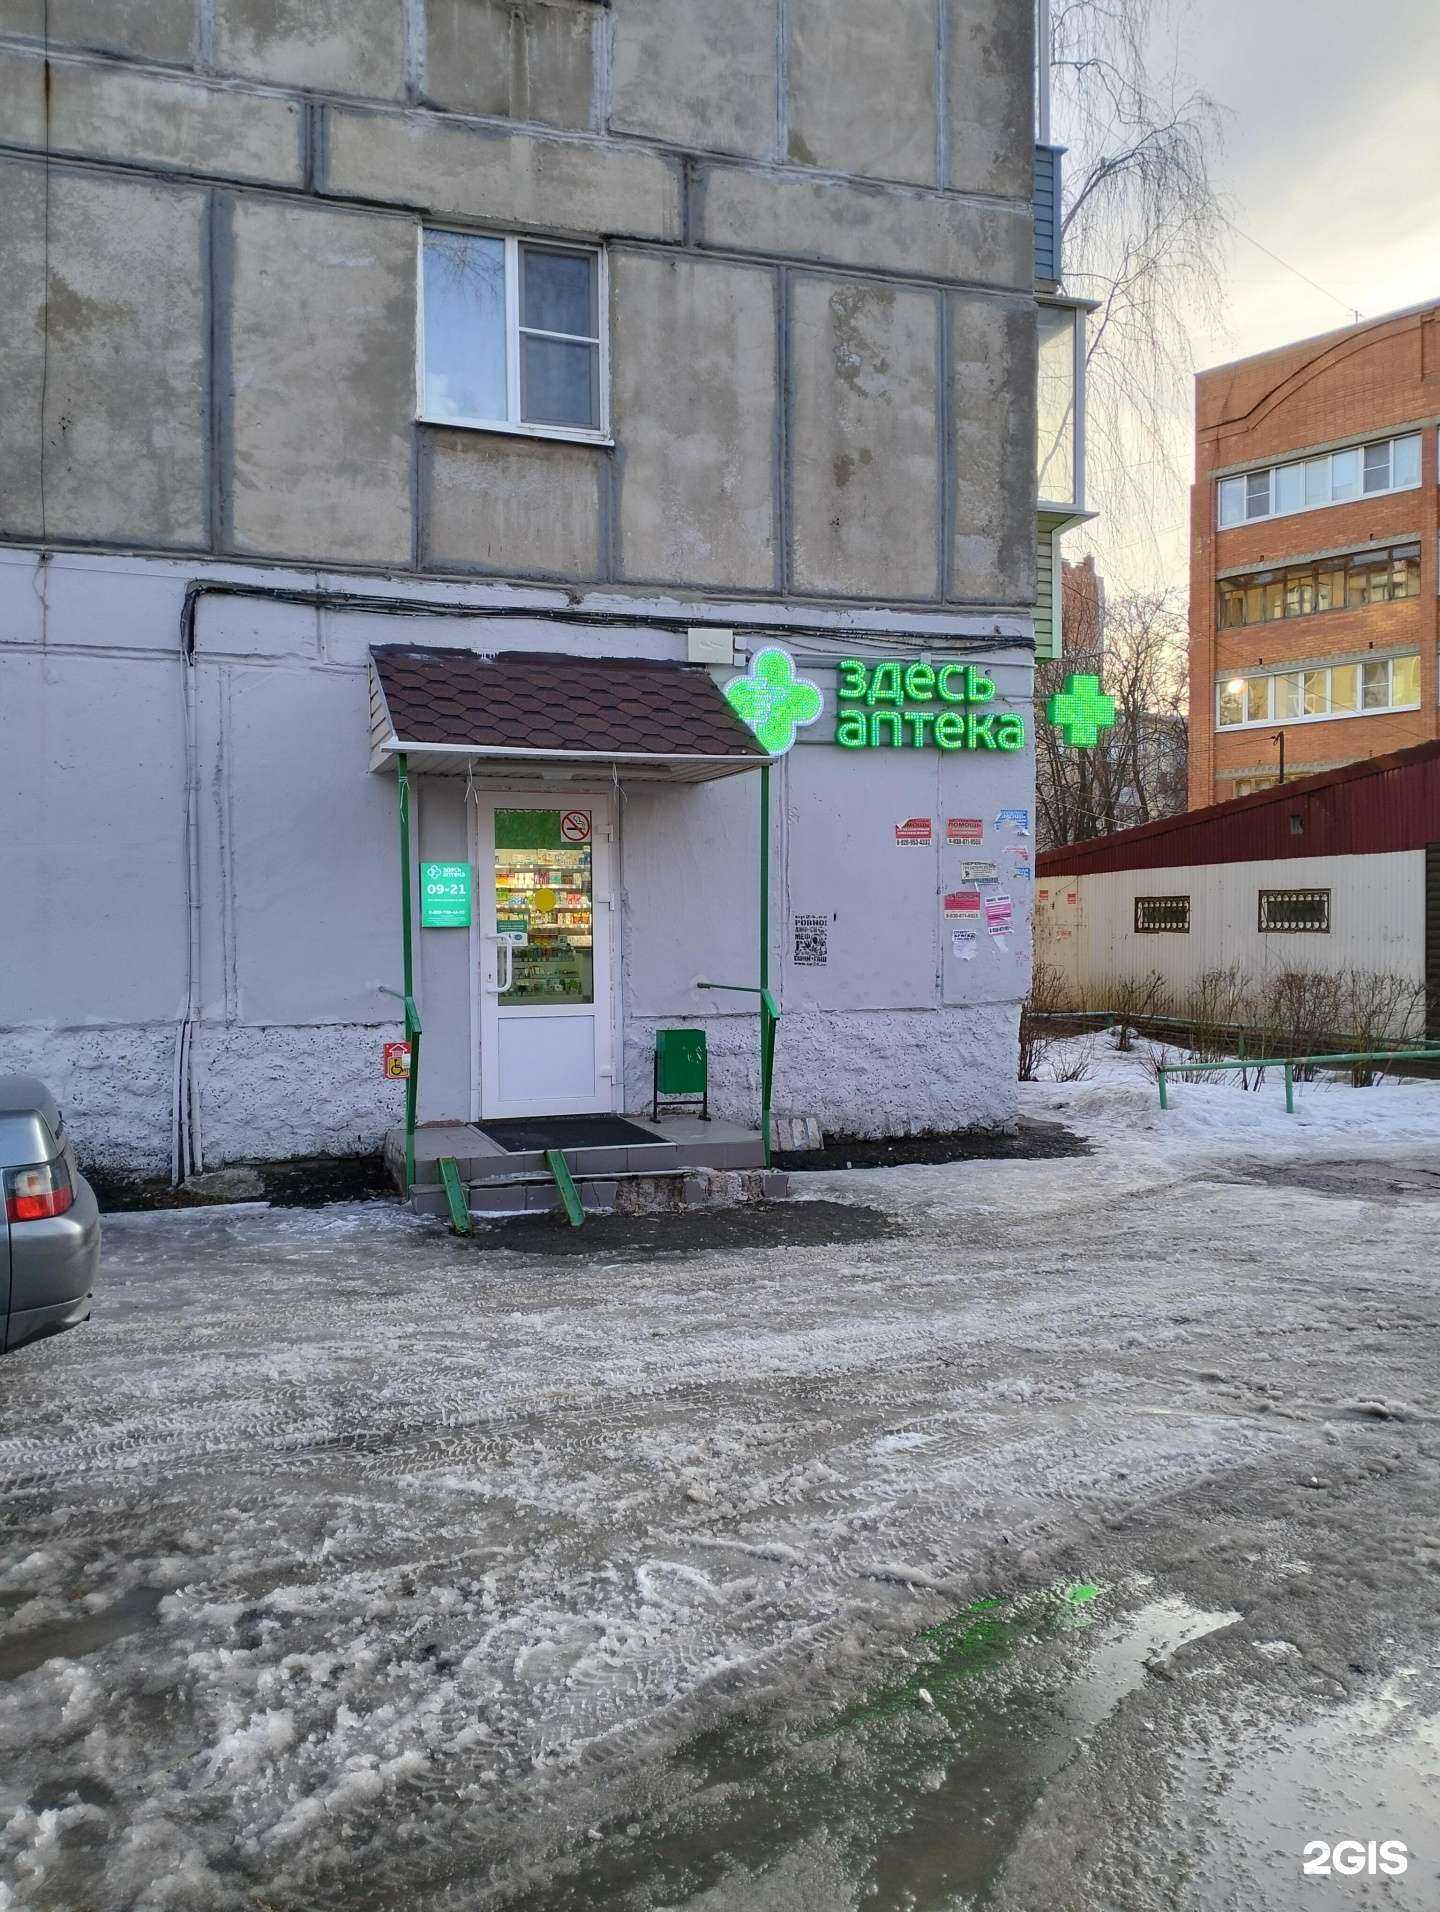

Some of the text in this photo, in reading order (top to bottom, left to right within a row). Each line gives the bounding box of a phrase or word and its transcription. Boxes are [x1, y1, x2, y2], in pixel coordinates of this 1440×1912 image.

[837, 660, 997, 706] здесь
[836, 709, 1025, 751] аптека
[427, 883, 466, 895] 09-21
